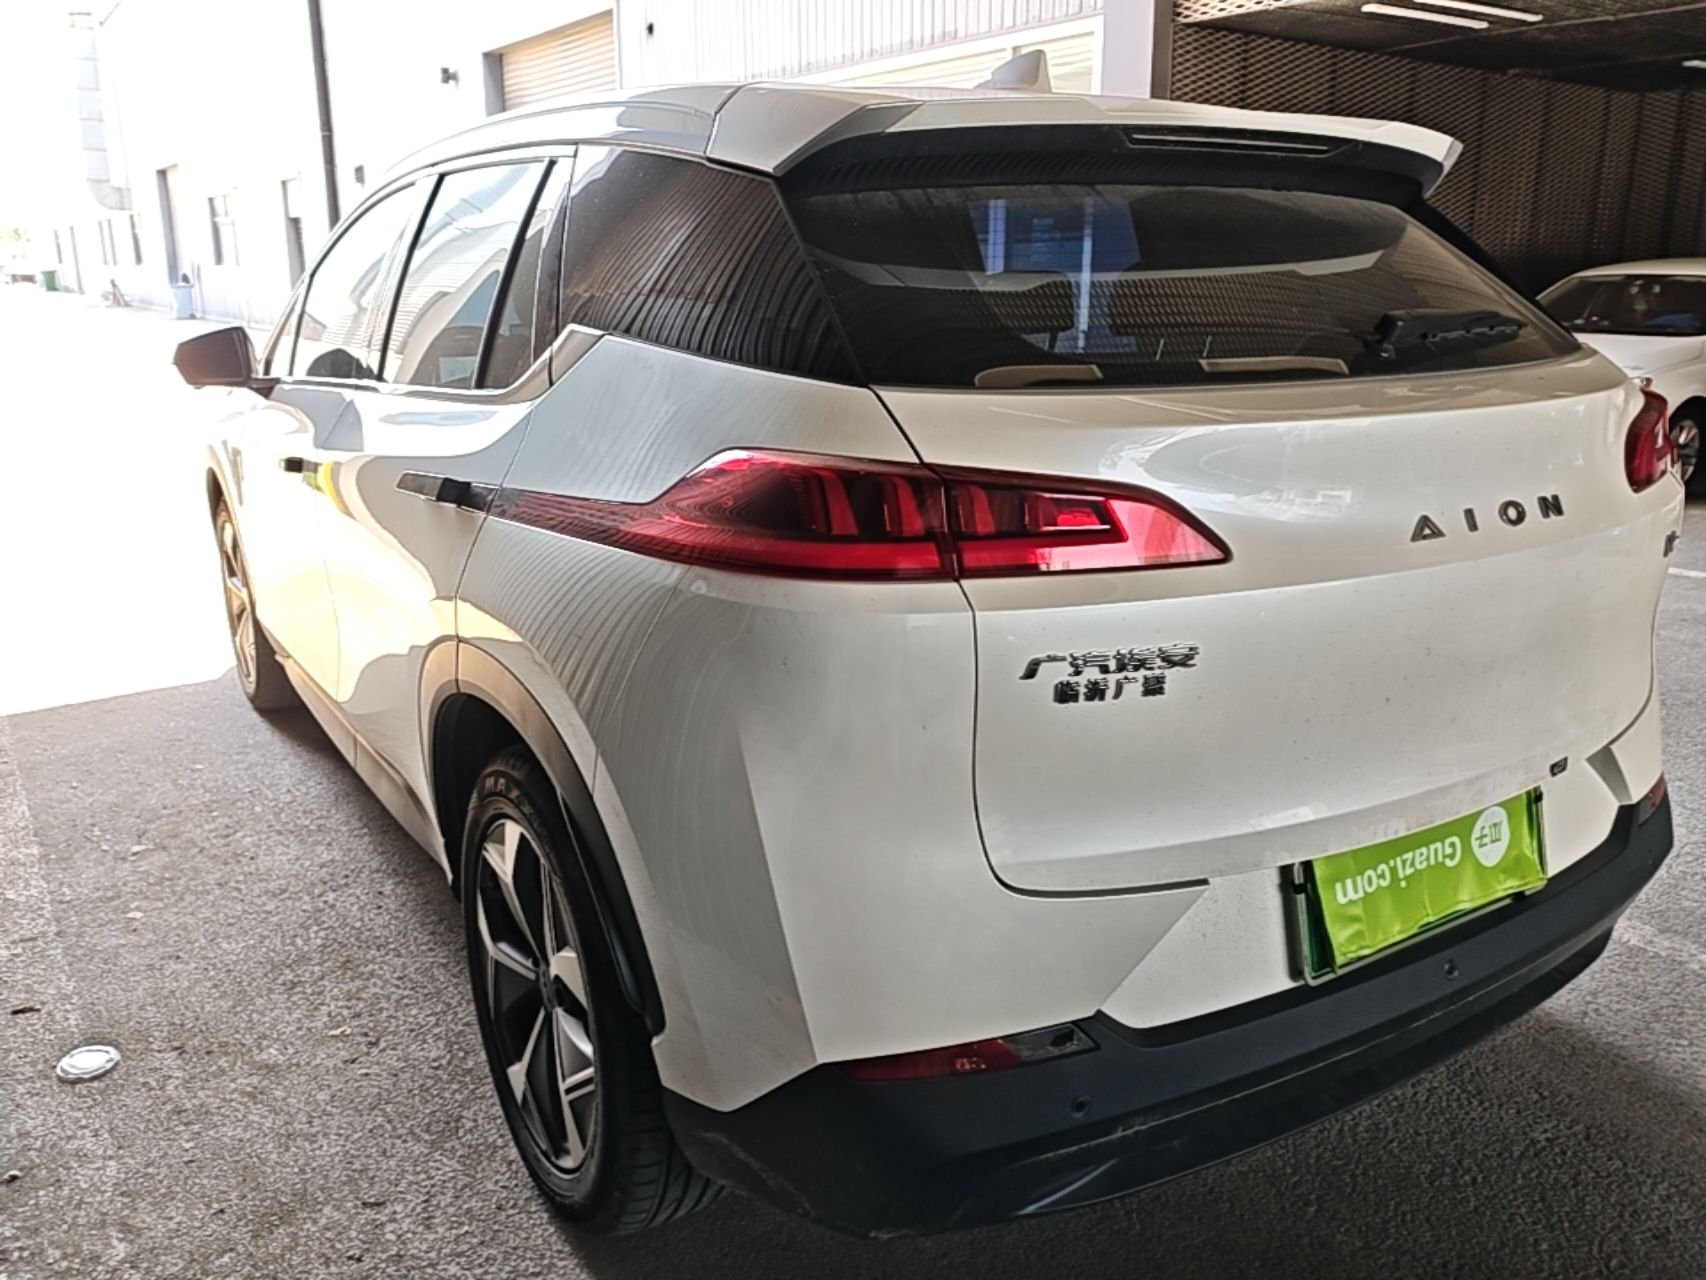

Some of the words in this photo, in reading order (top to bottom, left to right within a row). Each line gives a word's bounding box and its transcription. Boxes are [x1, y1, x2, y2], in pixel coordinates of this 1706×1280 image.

[1409, 494, 1565, 543] AION
[1018, 643, 1200, 680] 广汽埃安
[1474, 819, 1504, 849] 瓜子
[1334, 835, 1462, 904] Guazi.com
